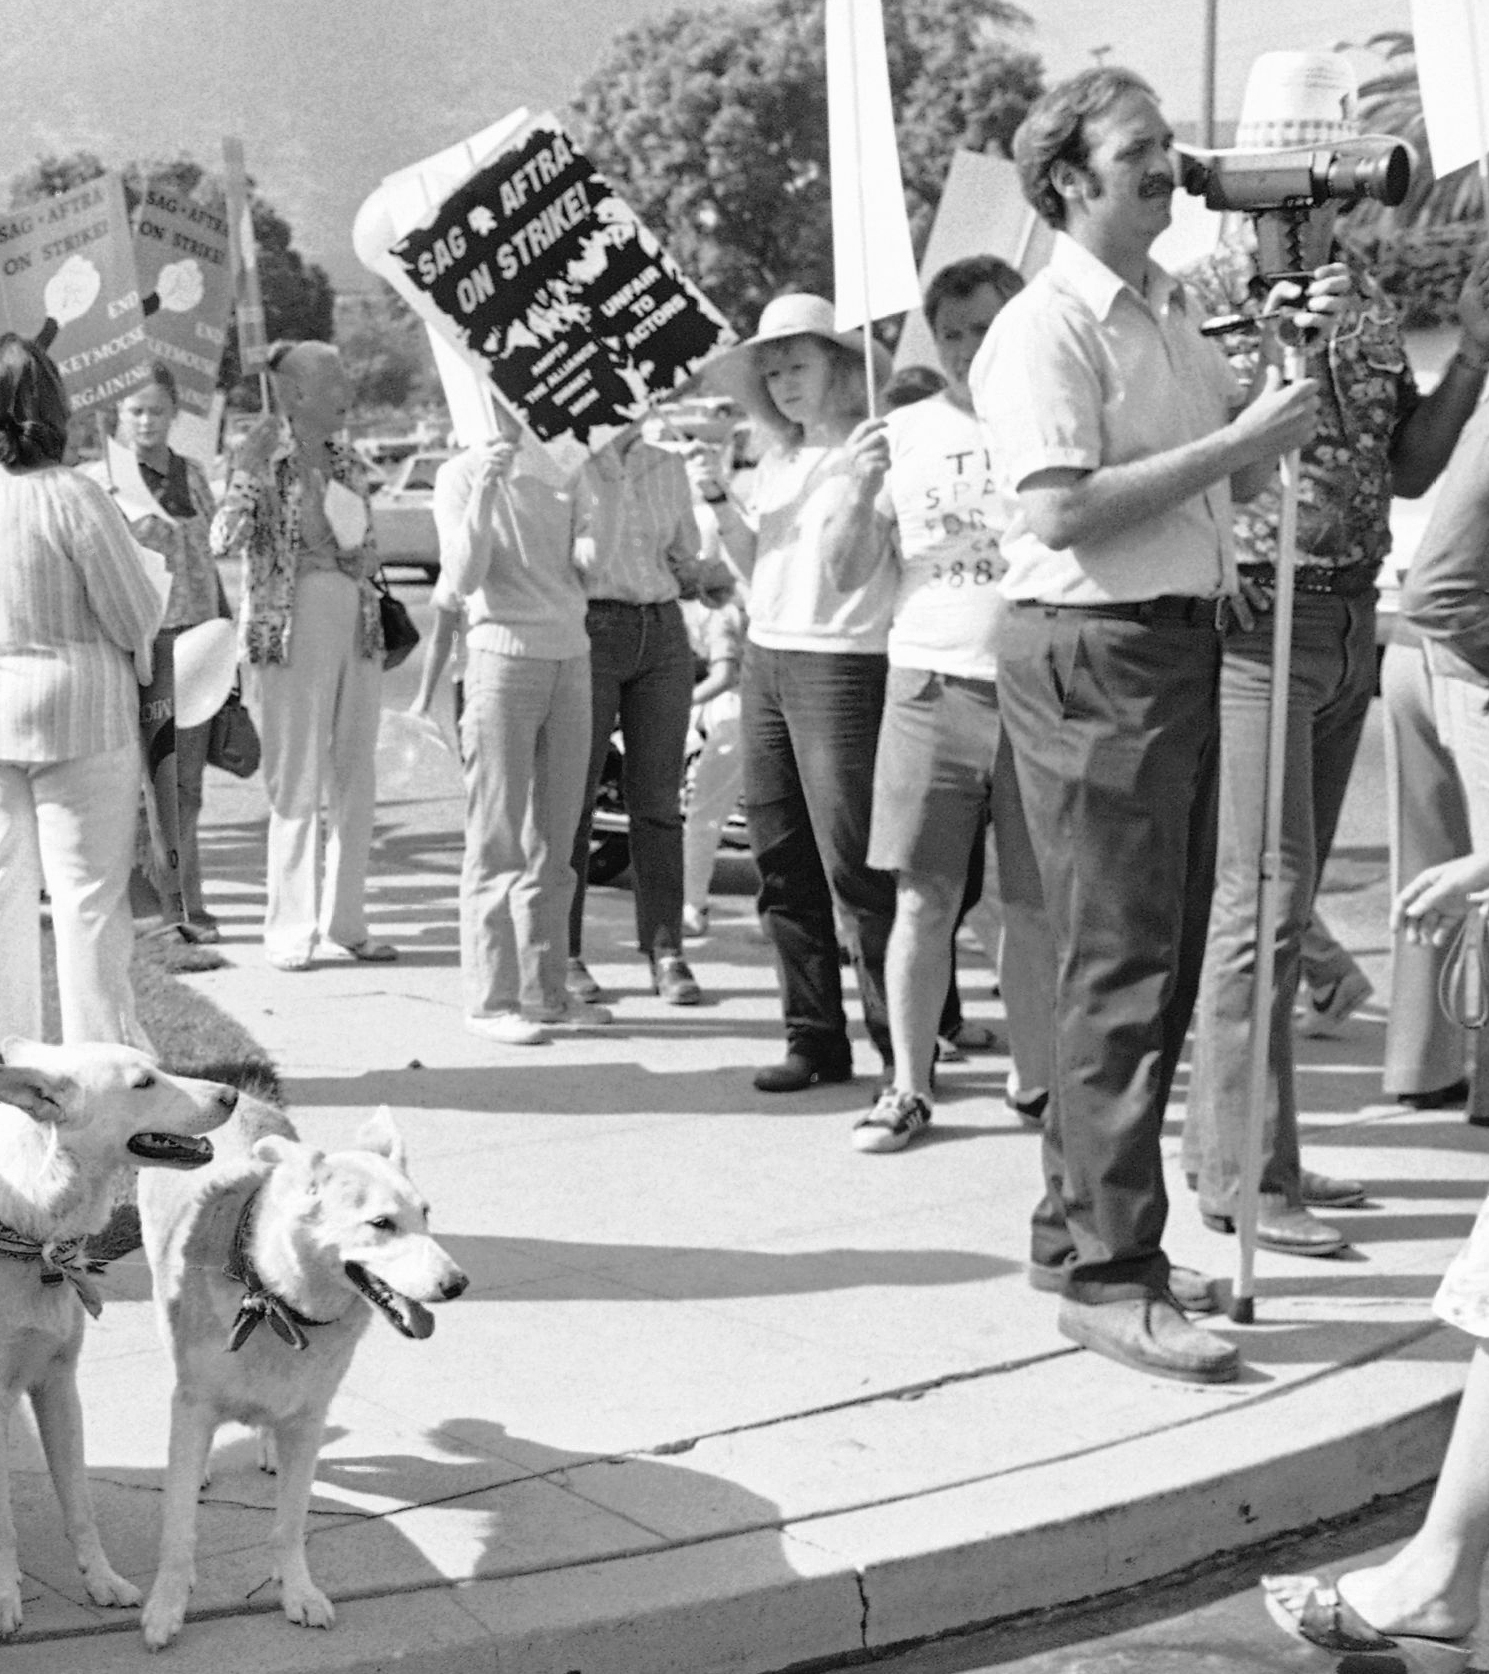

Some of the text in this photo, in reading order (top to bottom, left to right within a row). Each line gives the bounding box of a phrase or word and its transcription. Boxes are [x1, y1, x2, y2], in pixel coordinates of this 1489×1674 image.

[48, 190, 104, 224] AFTRA
[146, 191, 177, 213] SAG
[417, 136, 574, 285] SAG AFTRA
[139, 221, 165, 239] ON
[456, 180, 592, 314] ON STRIKE!
[4, 252, 32, 275] ON
[107, 291, 139, 319] END
[599, 265, 662, 318] UNFAIR
[628, 294, 656, 318] TO
[624, 293, 688, 350] ACTORS
